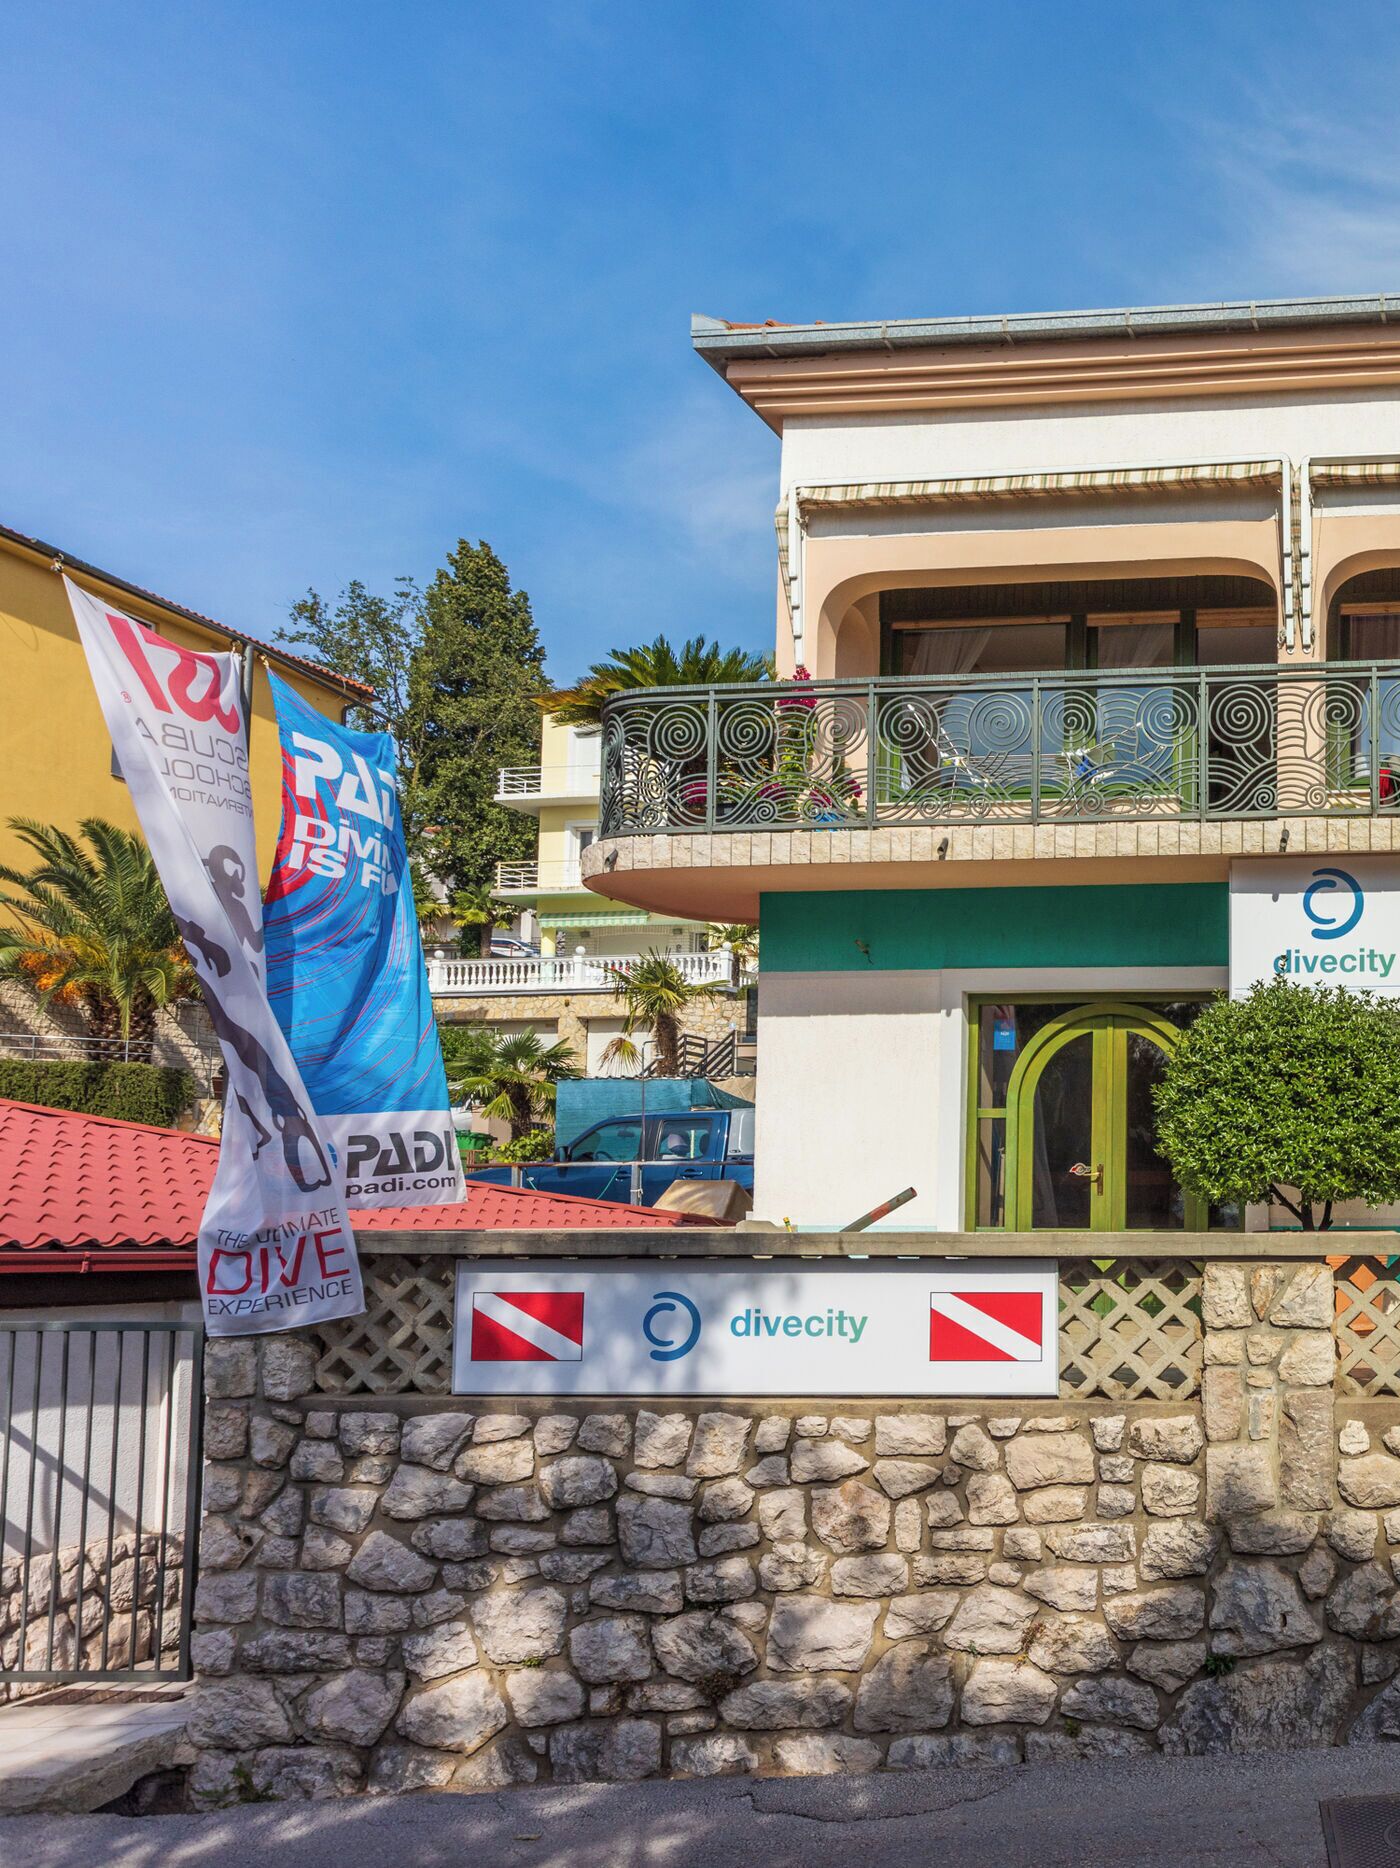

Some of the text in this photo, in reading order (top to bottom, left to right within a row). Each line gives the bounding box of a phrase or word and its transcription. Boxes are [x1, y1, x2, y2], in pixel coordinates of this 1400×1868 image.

[291, 730, 396, 832] PAD
[288, 842, 399, 896] IS FU
[1273, 947, 1397, 978] divecity
[346, 1130, 455, 1179] PADI
[345, 1175, 456, 1198] padi.com
[217, 1207, 341, 1249] THE ULIMATE
[206, 1227, 350, 1297] DIVE
[208, 1278, 354, 1316] EXPERIENCE
[730, 1308, 868, 1344] divecity
